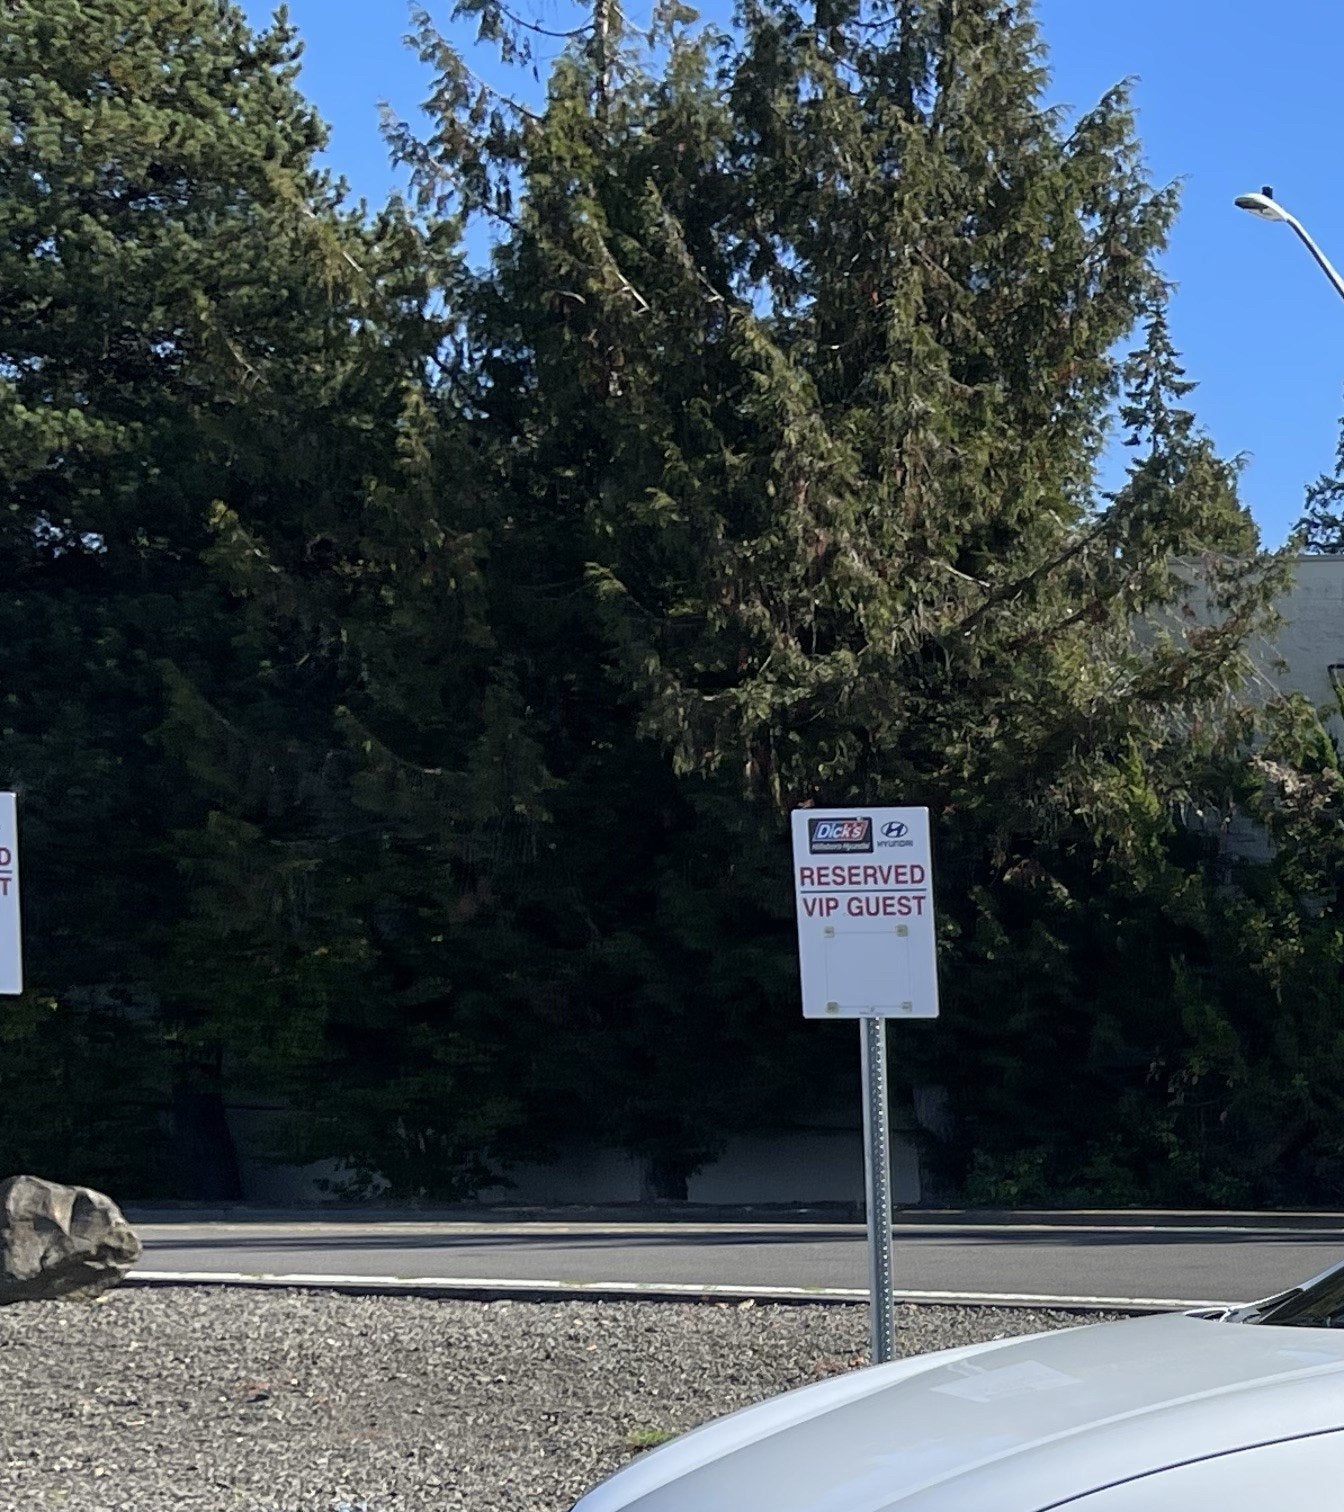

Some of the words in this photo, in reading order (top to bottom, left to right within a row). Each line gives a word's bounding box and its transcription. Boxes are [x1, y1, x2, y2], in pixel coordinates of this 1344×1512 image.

[800, 864, 925, 887] RESERVED
[802, 897, 840, 917] VIP
[847, 895, 927, 917] GUEST
